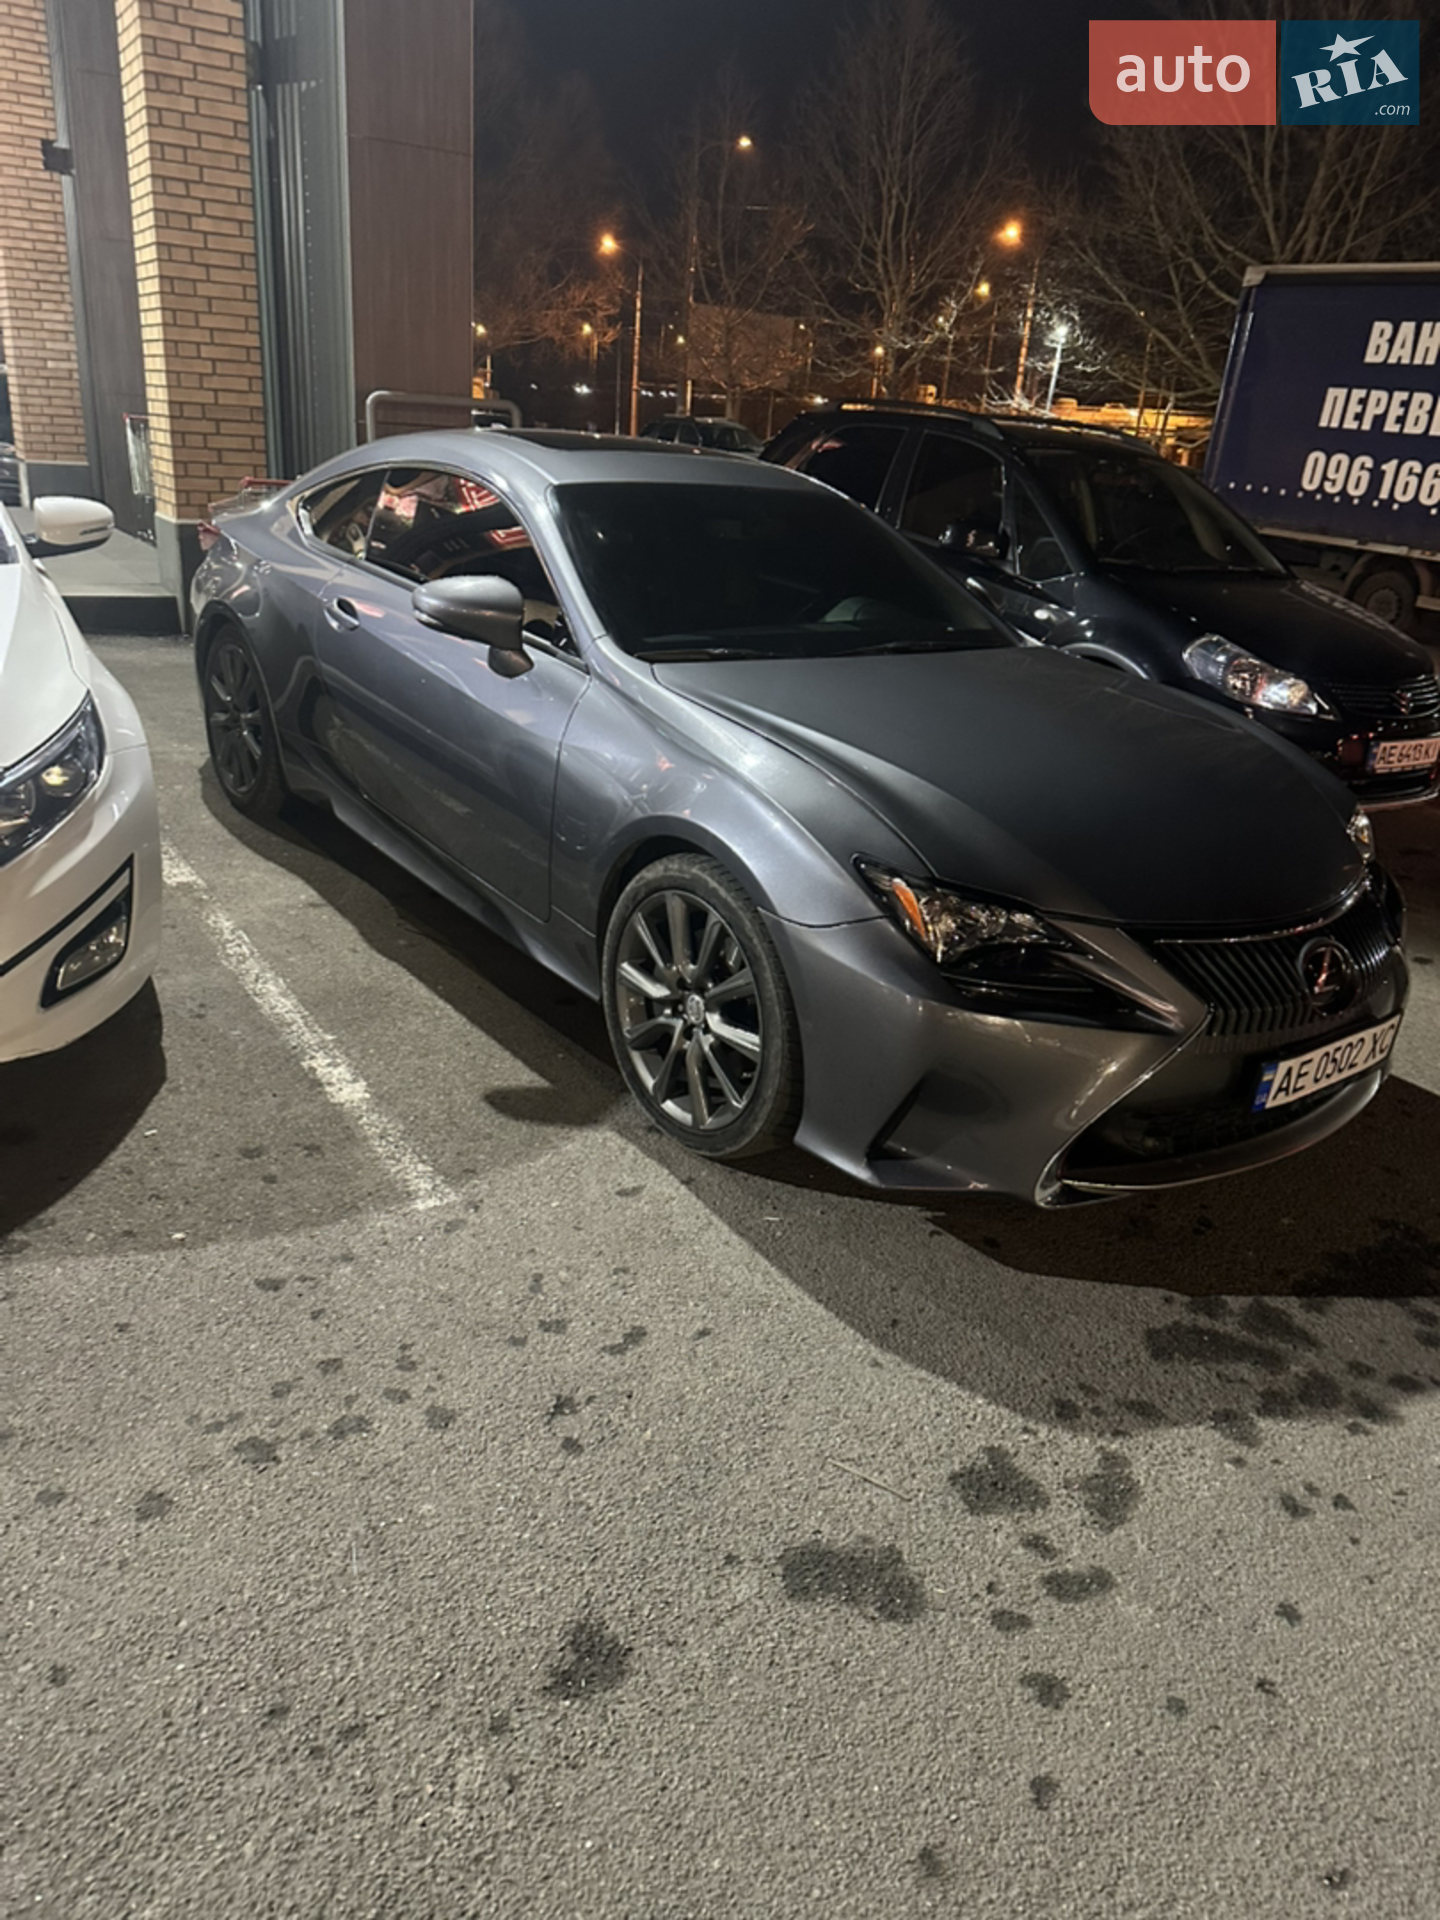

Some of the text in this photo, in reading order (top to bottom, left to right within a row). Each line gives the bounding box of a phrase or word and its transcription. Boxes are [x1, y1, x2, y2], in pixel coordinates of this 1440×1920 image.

[1301, 451, 1440, 506] 096 166
[1273, 1023, 1395, 1101] AE 0502 XC
